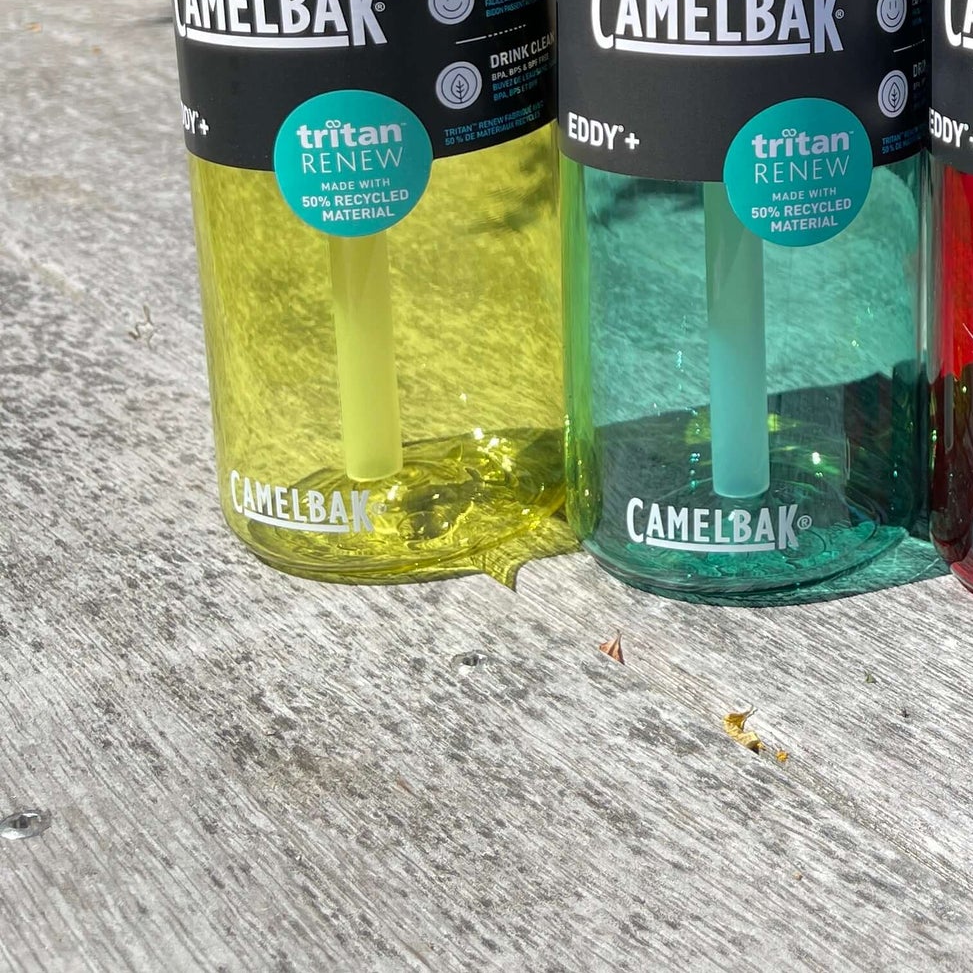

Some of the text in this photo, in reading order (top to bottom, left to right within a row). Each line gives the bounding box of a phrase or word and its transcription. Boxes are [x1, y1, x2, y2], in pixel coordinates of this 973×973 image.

[490, 44, 529, 69] DRINK
[478, 116, 505, 130] RENEW
[465, 131, 476, 141] DE
[302, 146, 403, 174] RENEW
[755, 155, 849, 184] RENEW
[321, 178, 390, 191] MADE WITH
[302, 189, 409, 207] 50% RECYCLED
[772, 187, 837, 201] MADE WITH
[322, 206, 395, 221] MATERIAL
[751, 198, 852, 219] 50% RECYCLED
[771, 215, 838, 232] MATERIAL
